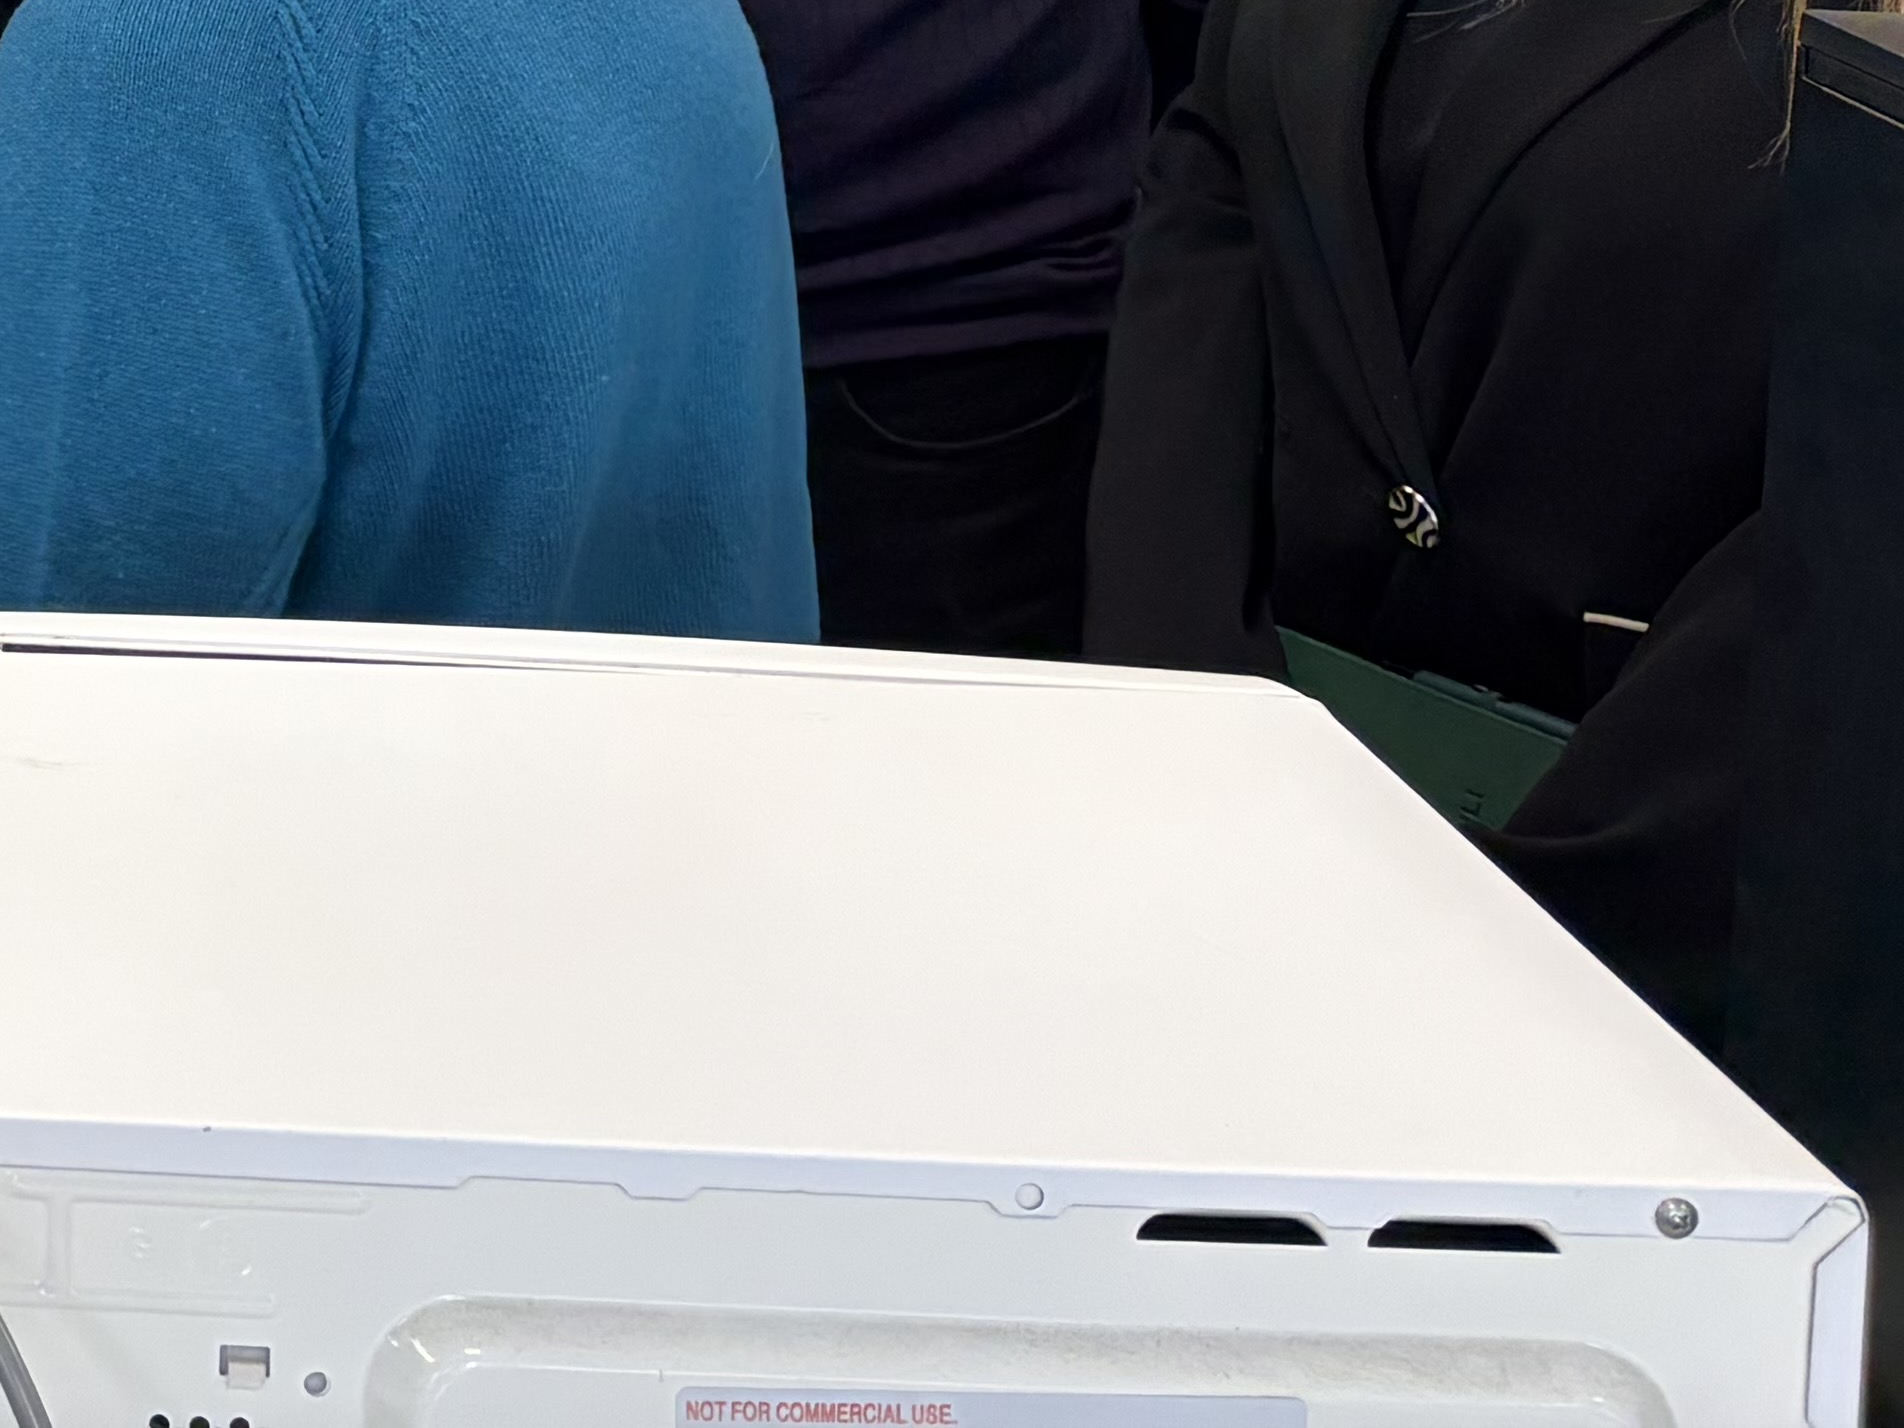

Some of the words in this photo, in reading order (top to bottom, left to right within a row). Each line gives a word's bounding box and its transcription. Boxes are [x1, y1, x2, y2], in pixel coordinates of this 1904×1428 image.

[686, 1400, 726, 1422] NOT
[731, 1401, 770, 1423] FOR
[776, 1402, 908, 1425] COMMERCIAL
[911, 1403, 958, 1425] USE.
